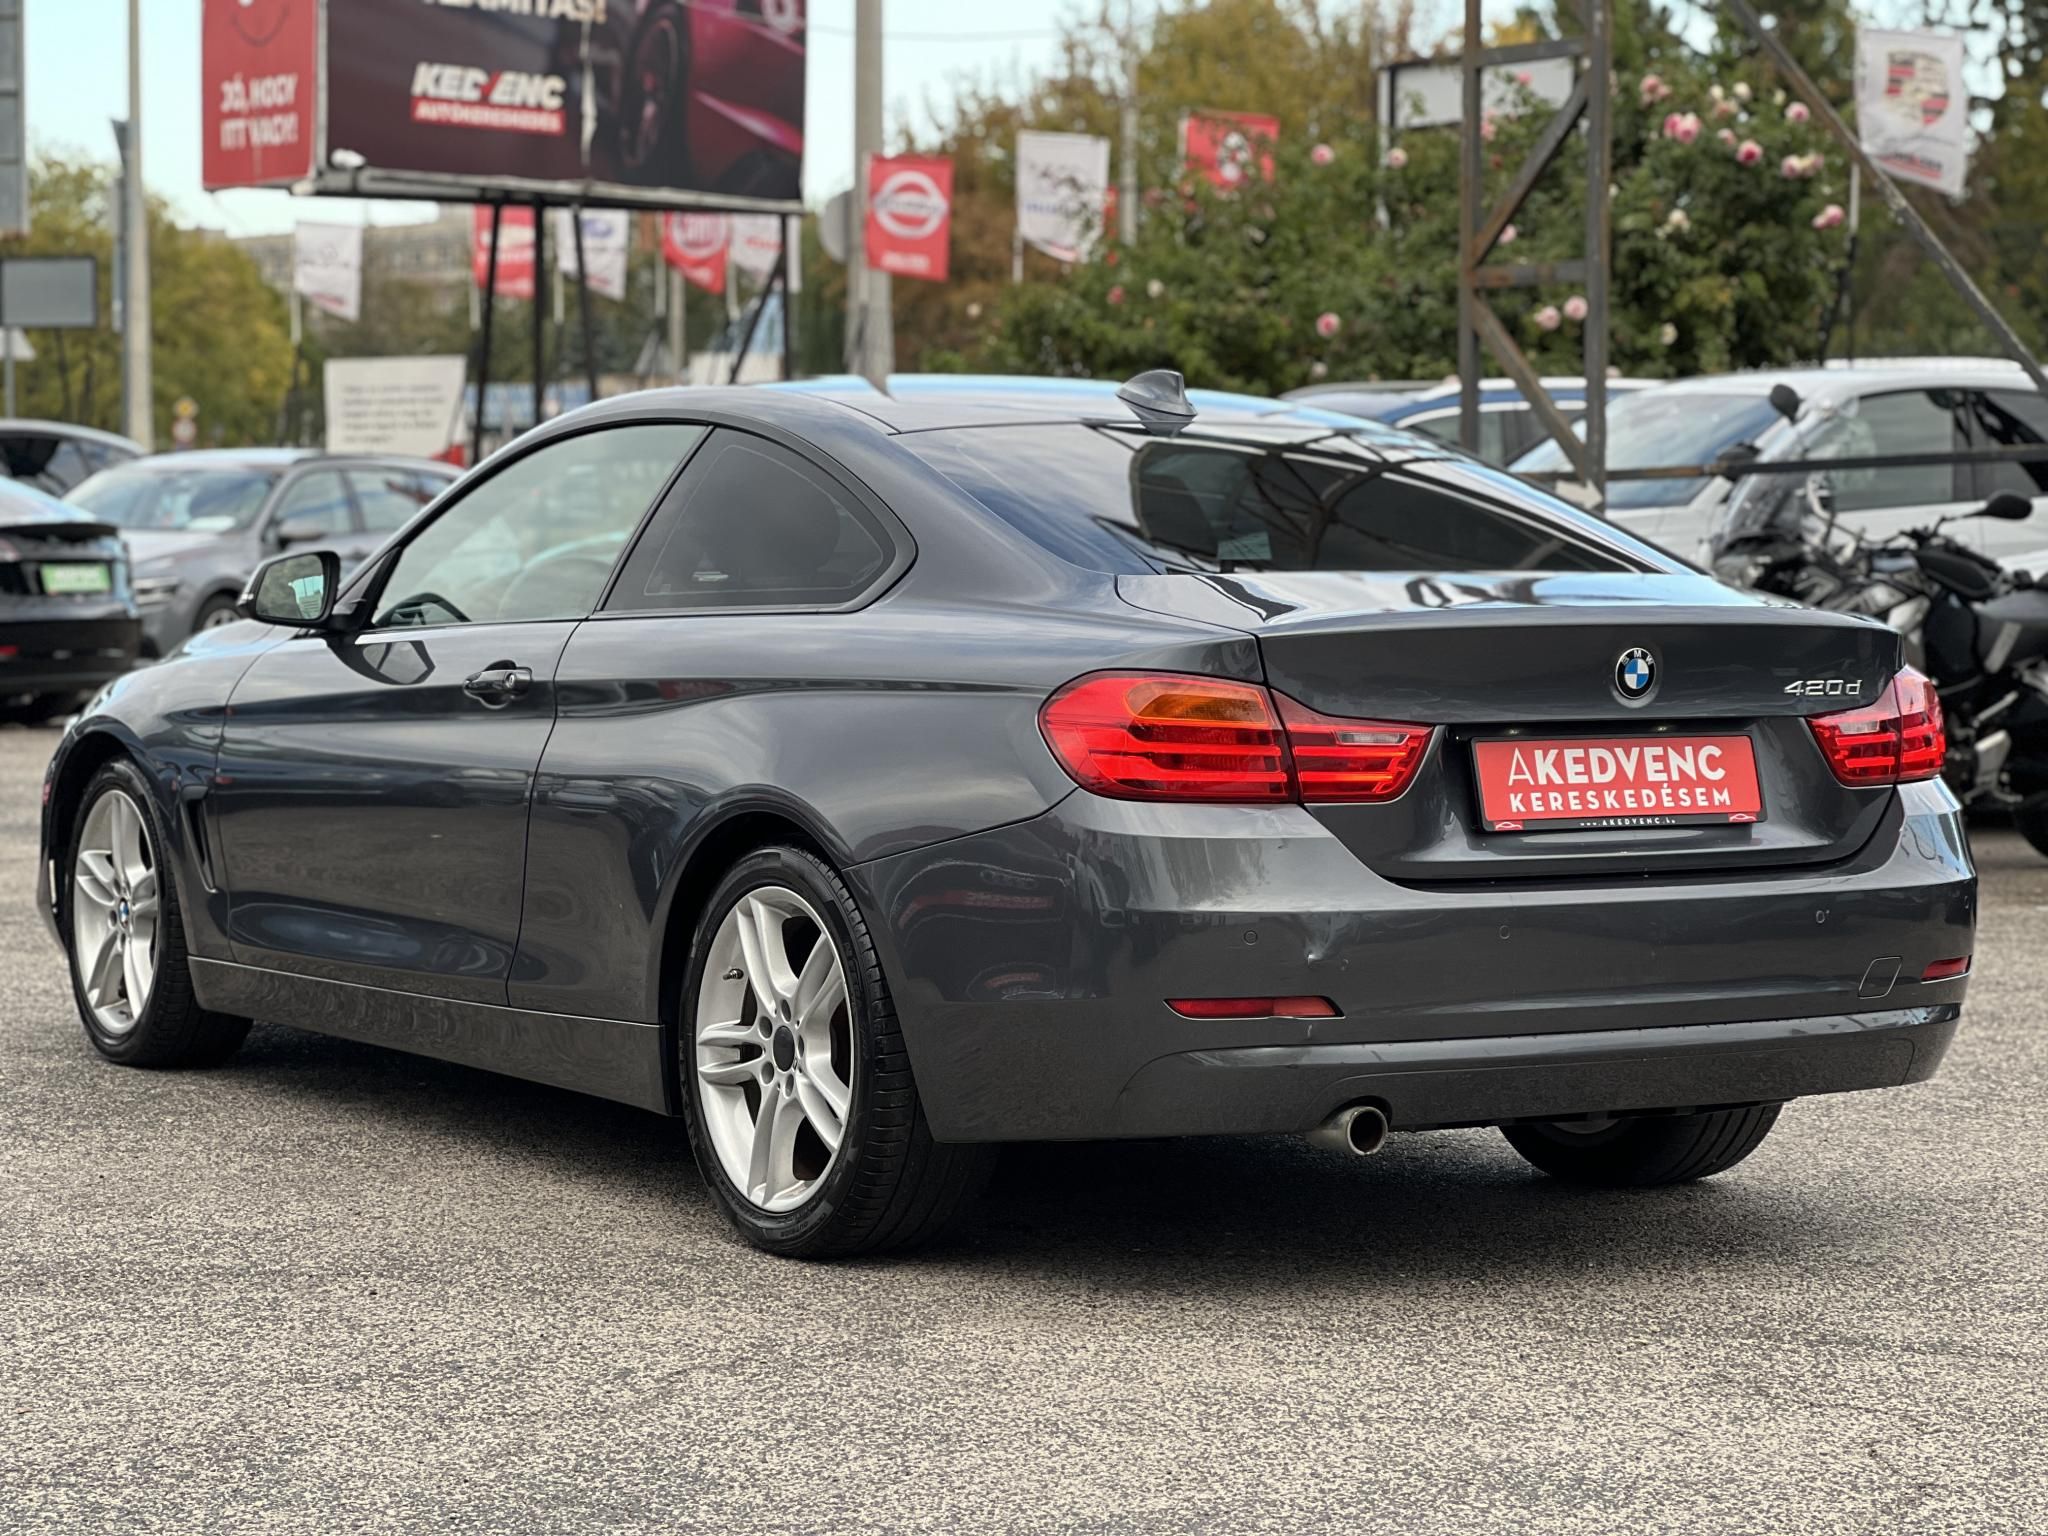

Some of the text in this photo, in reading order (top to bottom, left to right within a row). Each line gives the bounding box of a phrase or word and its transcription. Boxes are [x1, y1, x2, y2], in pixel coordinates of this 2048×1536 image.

[1620, 649, 1655, 666] BMW
[1783, 679, 1863, 697] 420d
[1509, 782, 1732, 813] KERESKEDÉSEM
